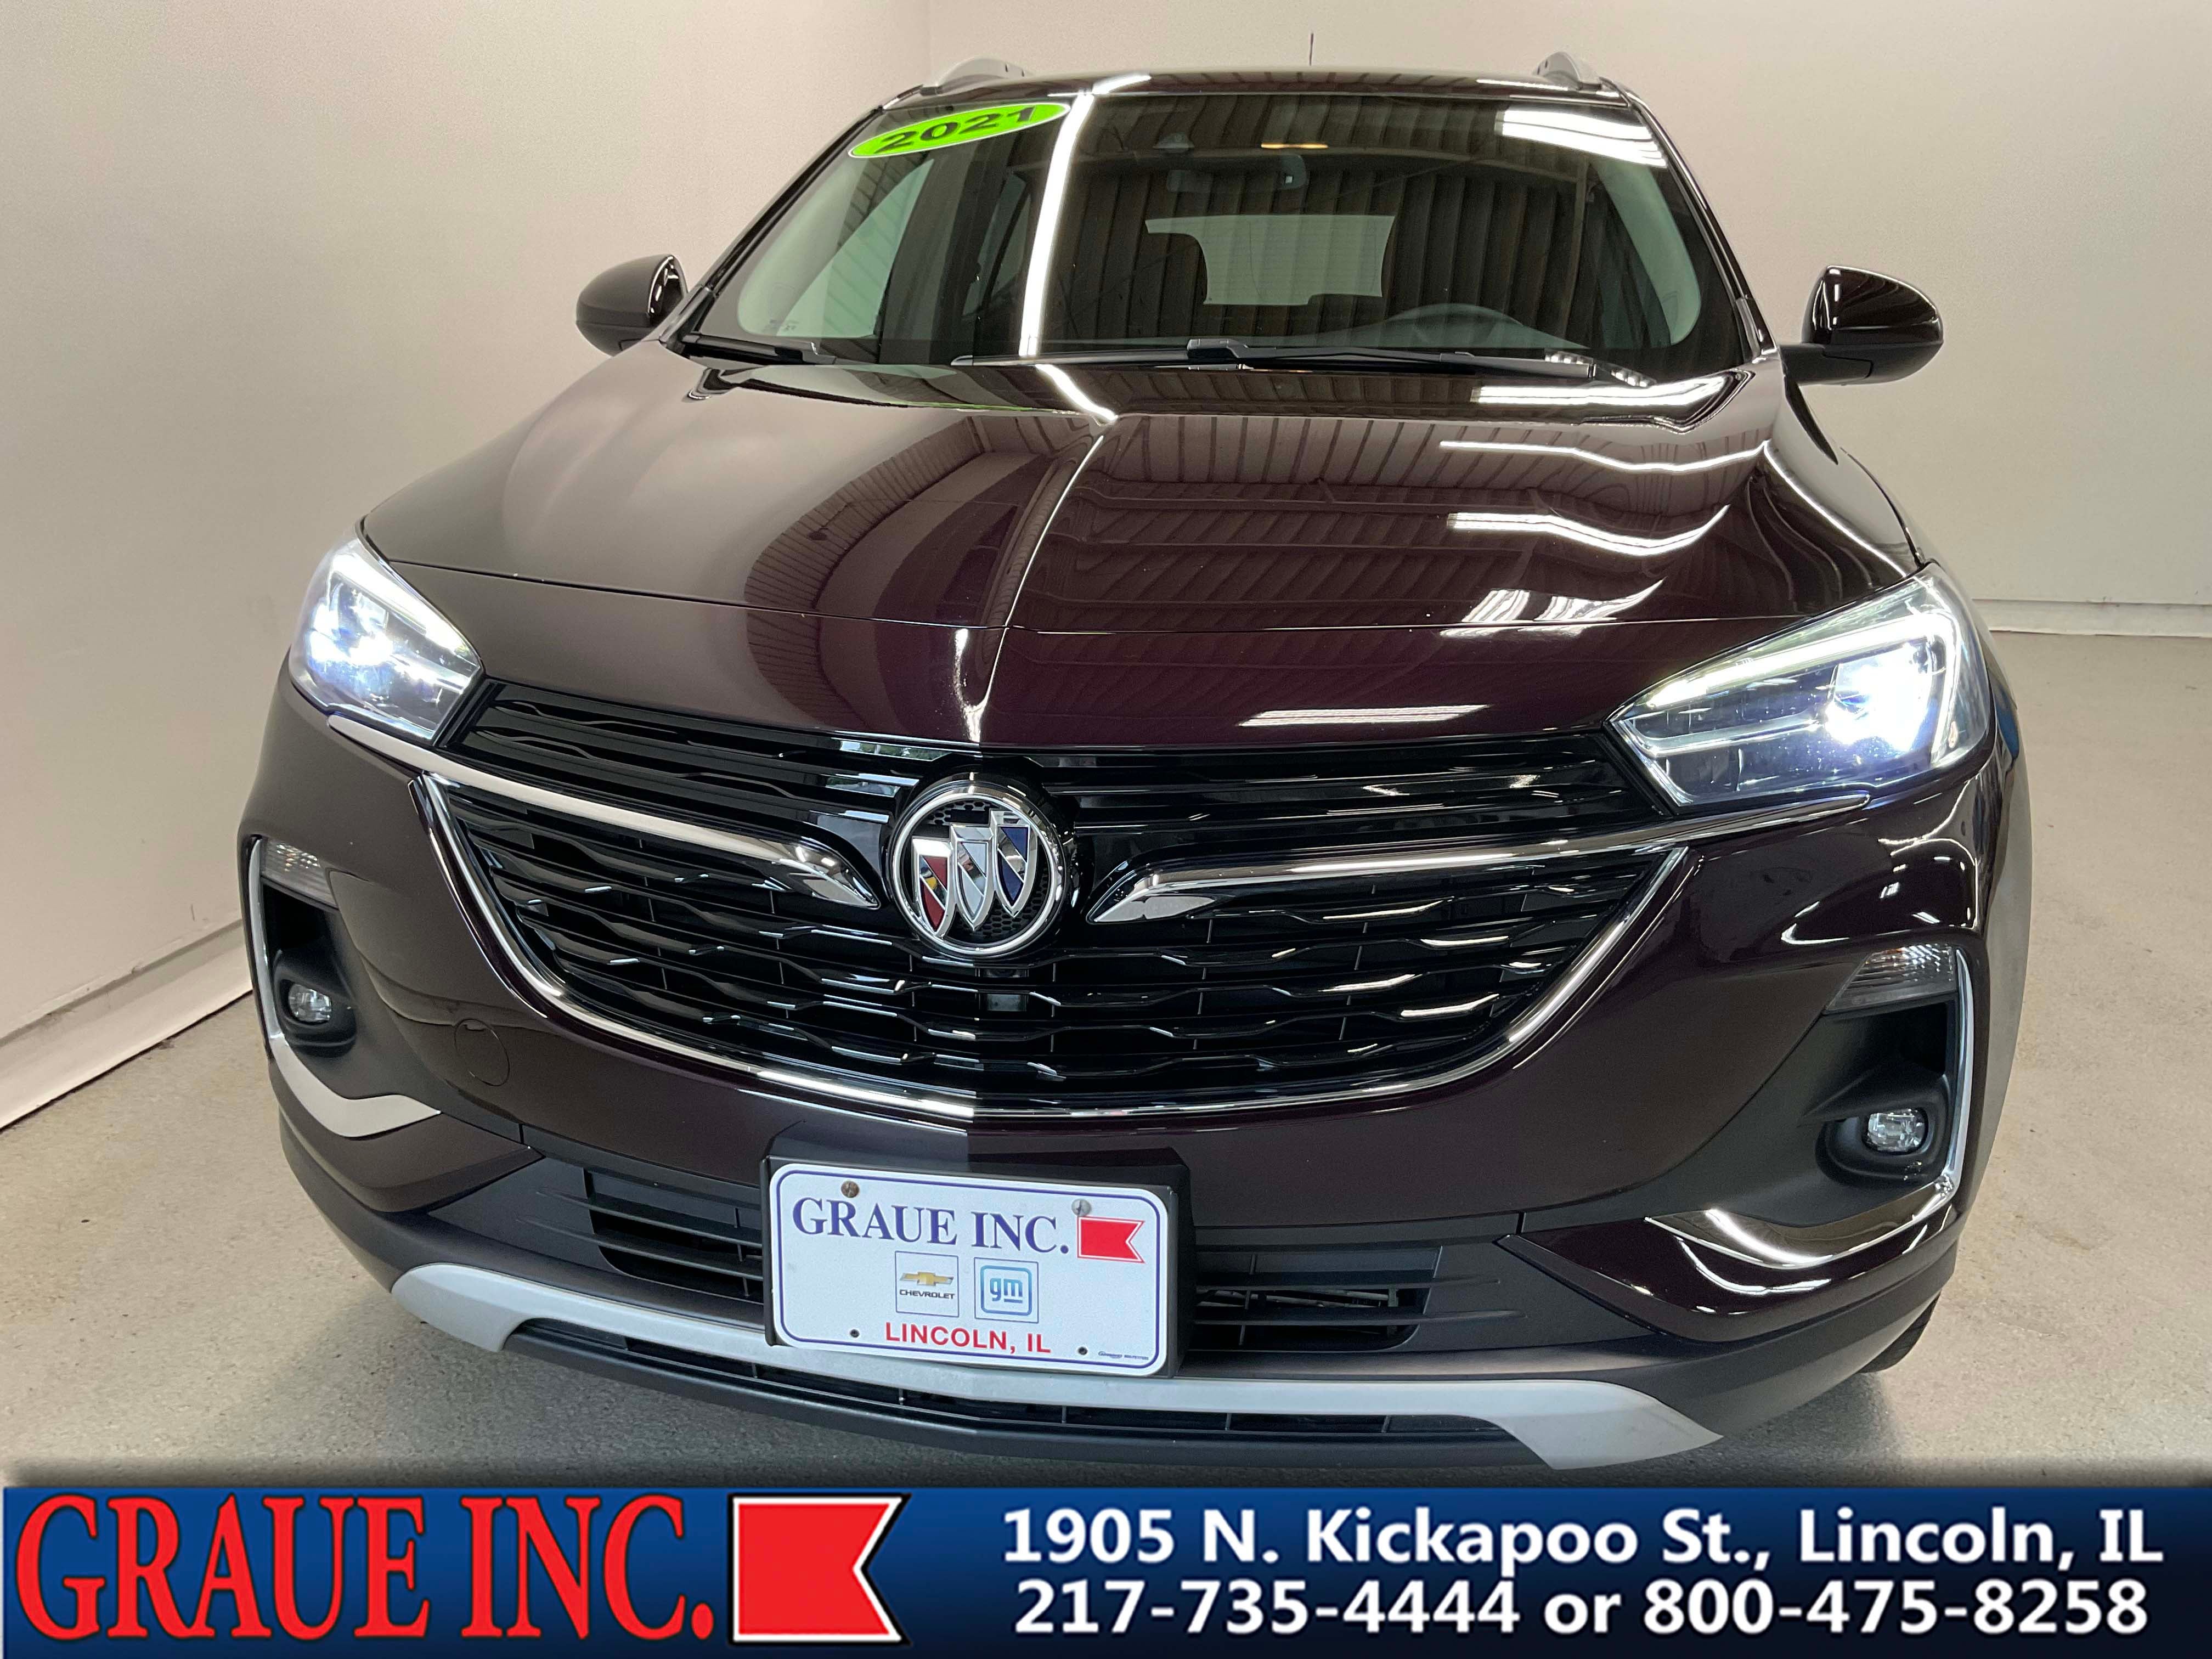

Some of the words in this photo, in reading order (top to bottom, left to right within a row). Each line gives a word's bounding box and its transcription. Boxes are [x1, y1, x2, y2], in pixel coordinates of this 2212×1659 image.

[874, 106, 1036, 154] 2021
[792, 1197, 957, 1245] GRAUE
[970, 1211, 1069, 1254] INC.
[899, 1289, 955, 1300] CHEVROLET
[989, 1278, 1024, 1304] gm
[885, 1323, 1015, 1353] LINCOLN,
[1028, 1334, 1051, 1353] IL
